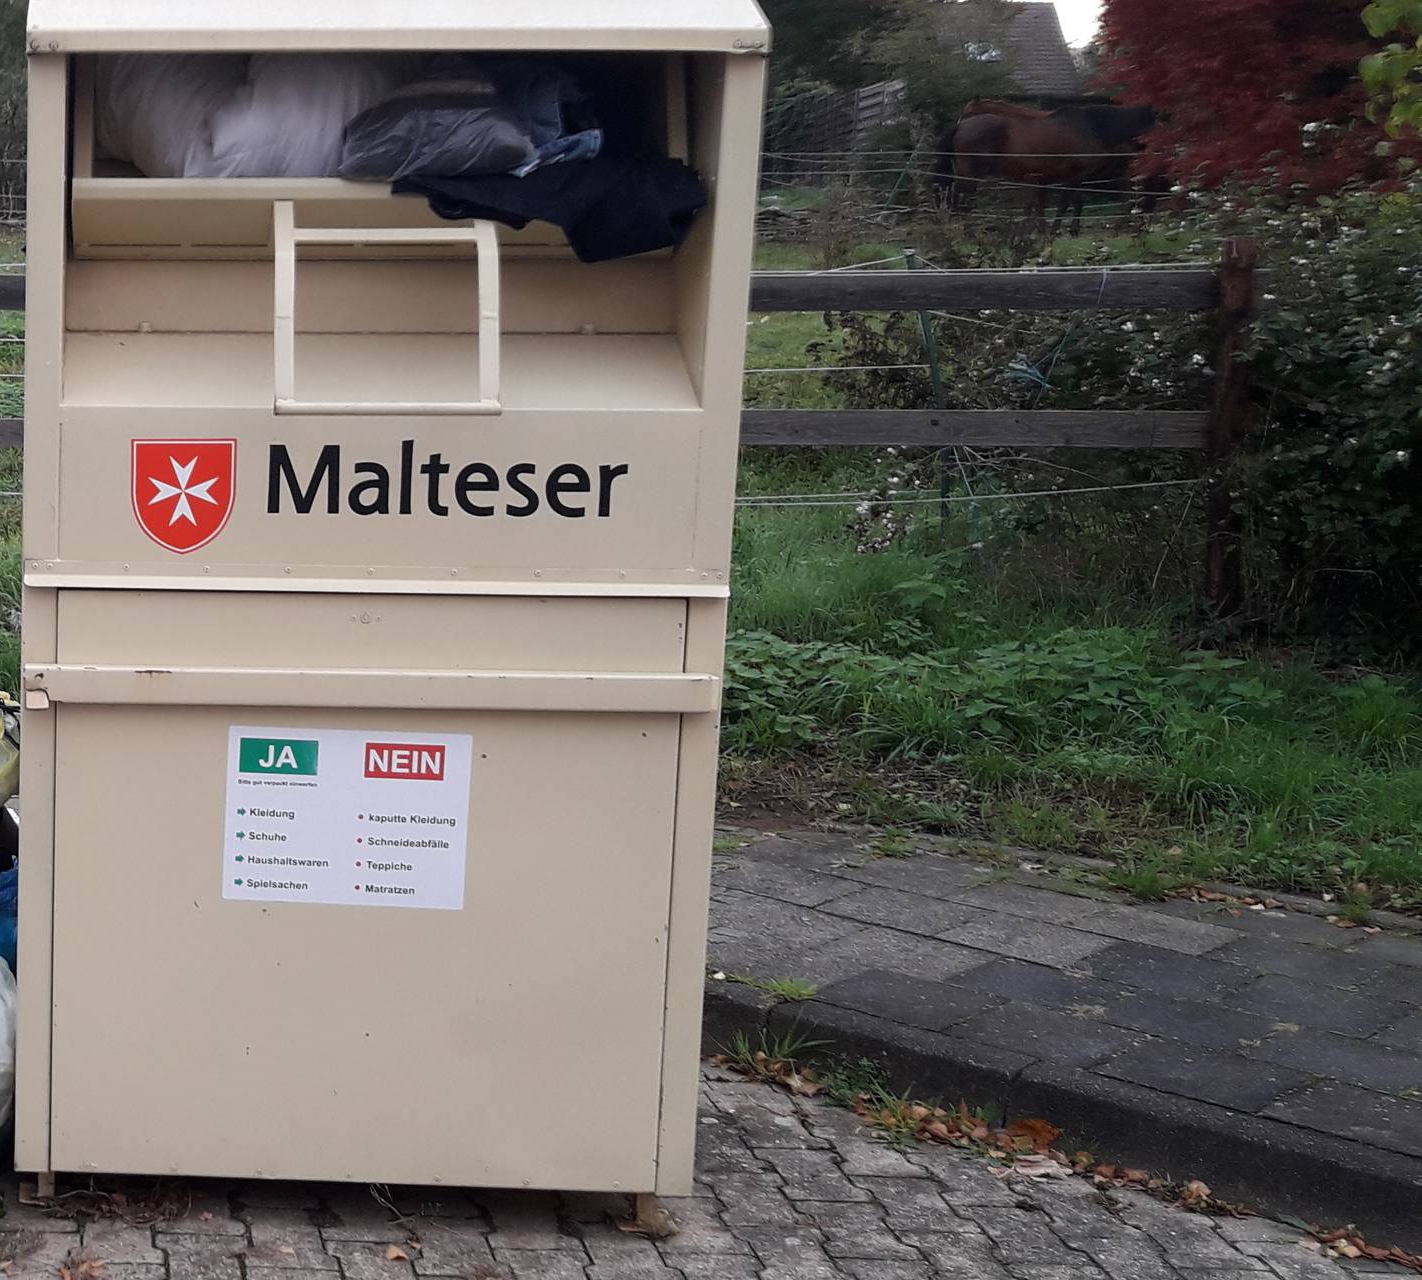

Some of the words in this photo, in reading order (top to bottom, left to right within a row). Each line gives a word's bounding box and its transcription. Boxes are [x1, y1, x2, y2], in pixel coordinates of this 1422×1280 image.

[266, 439, 629, 518] Malteser
[258, 744, 298, 769] JA
[367, 748, 442, 775] NEIN
[249, 807, 295, 820] Kleidung
[368, 813, 407, 825] kaputte
[410, 814, 456, 827] Kleidung
[248, 831, 287, 842] Schuhe
[367, 836, 450, 849] Schneideabfälle
[247, 855, 329, 868] Haushaltswaren
[366, 860, 413, 873] Teppiche
[246, 878, 309, 891] Spielsachen
[364, 884, 415, 896] Matratzen
